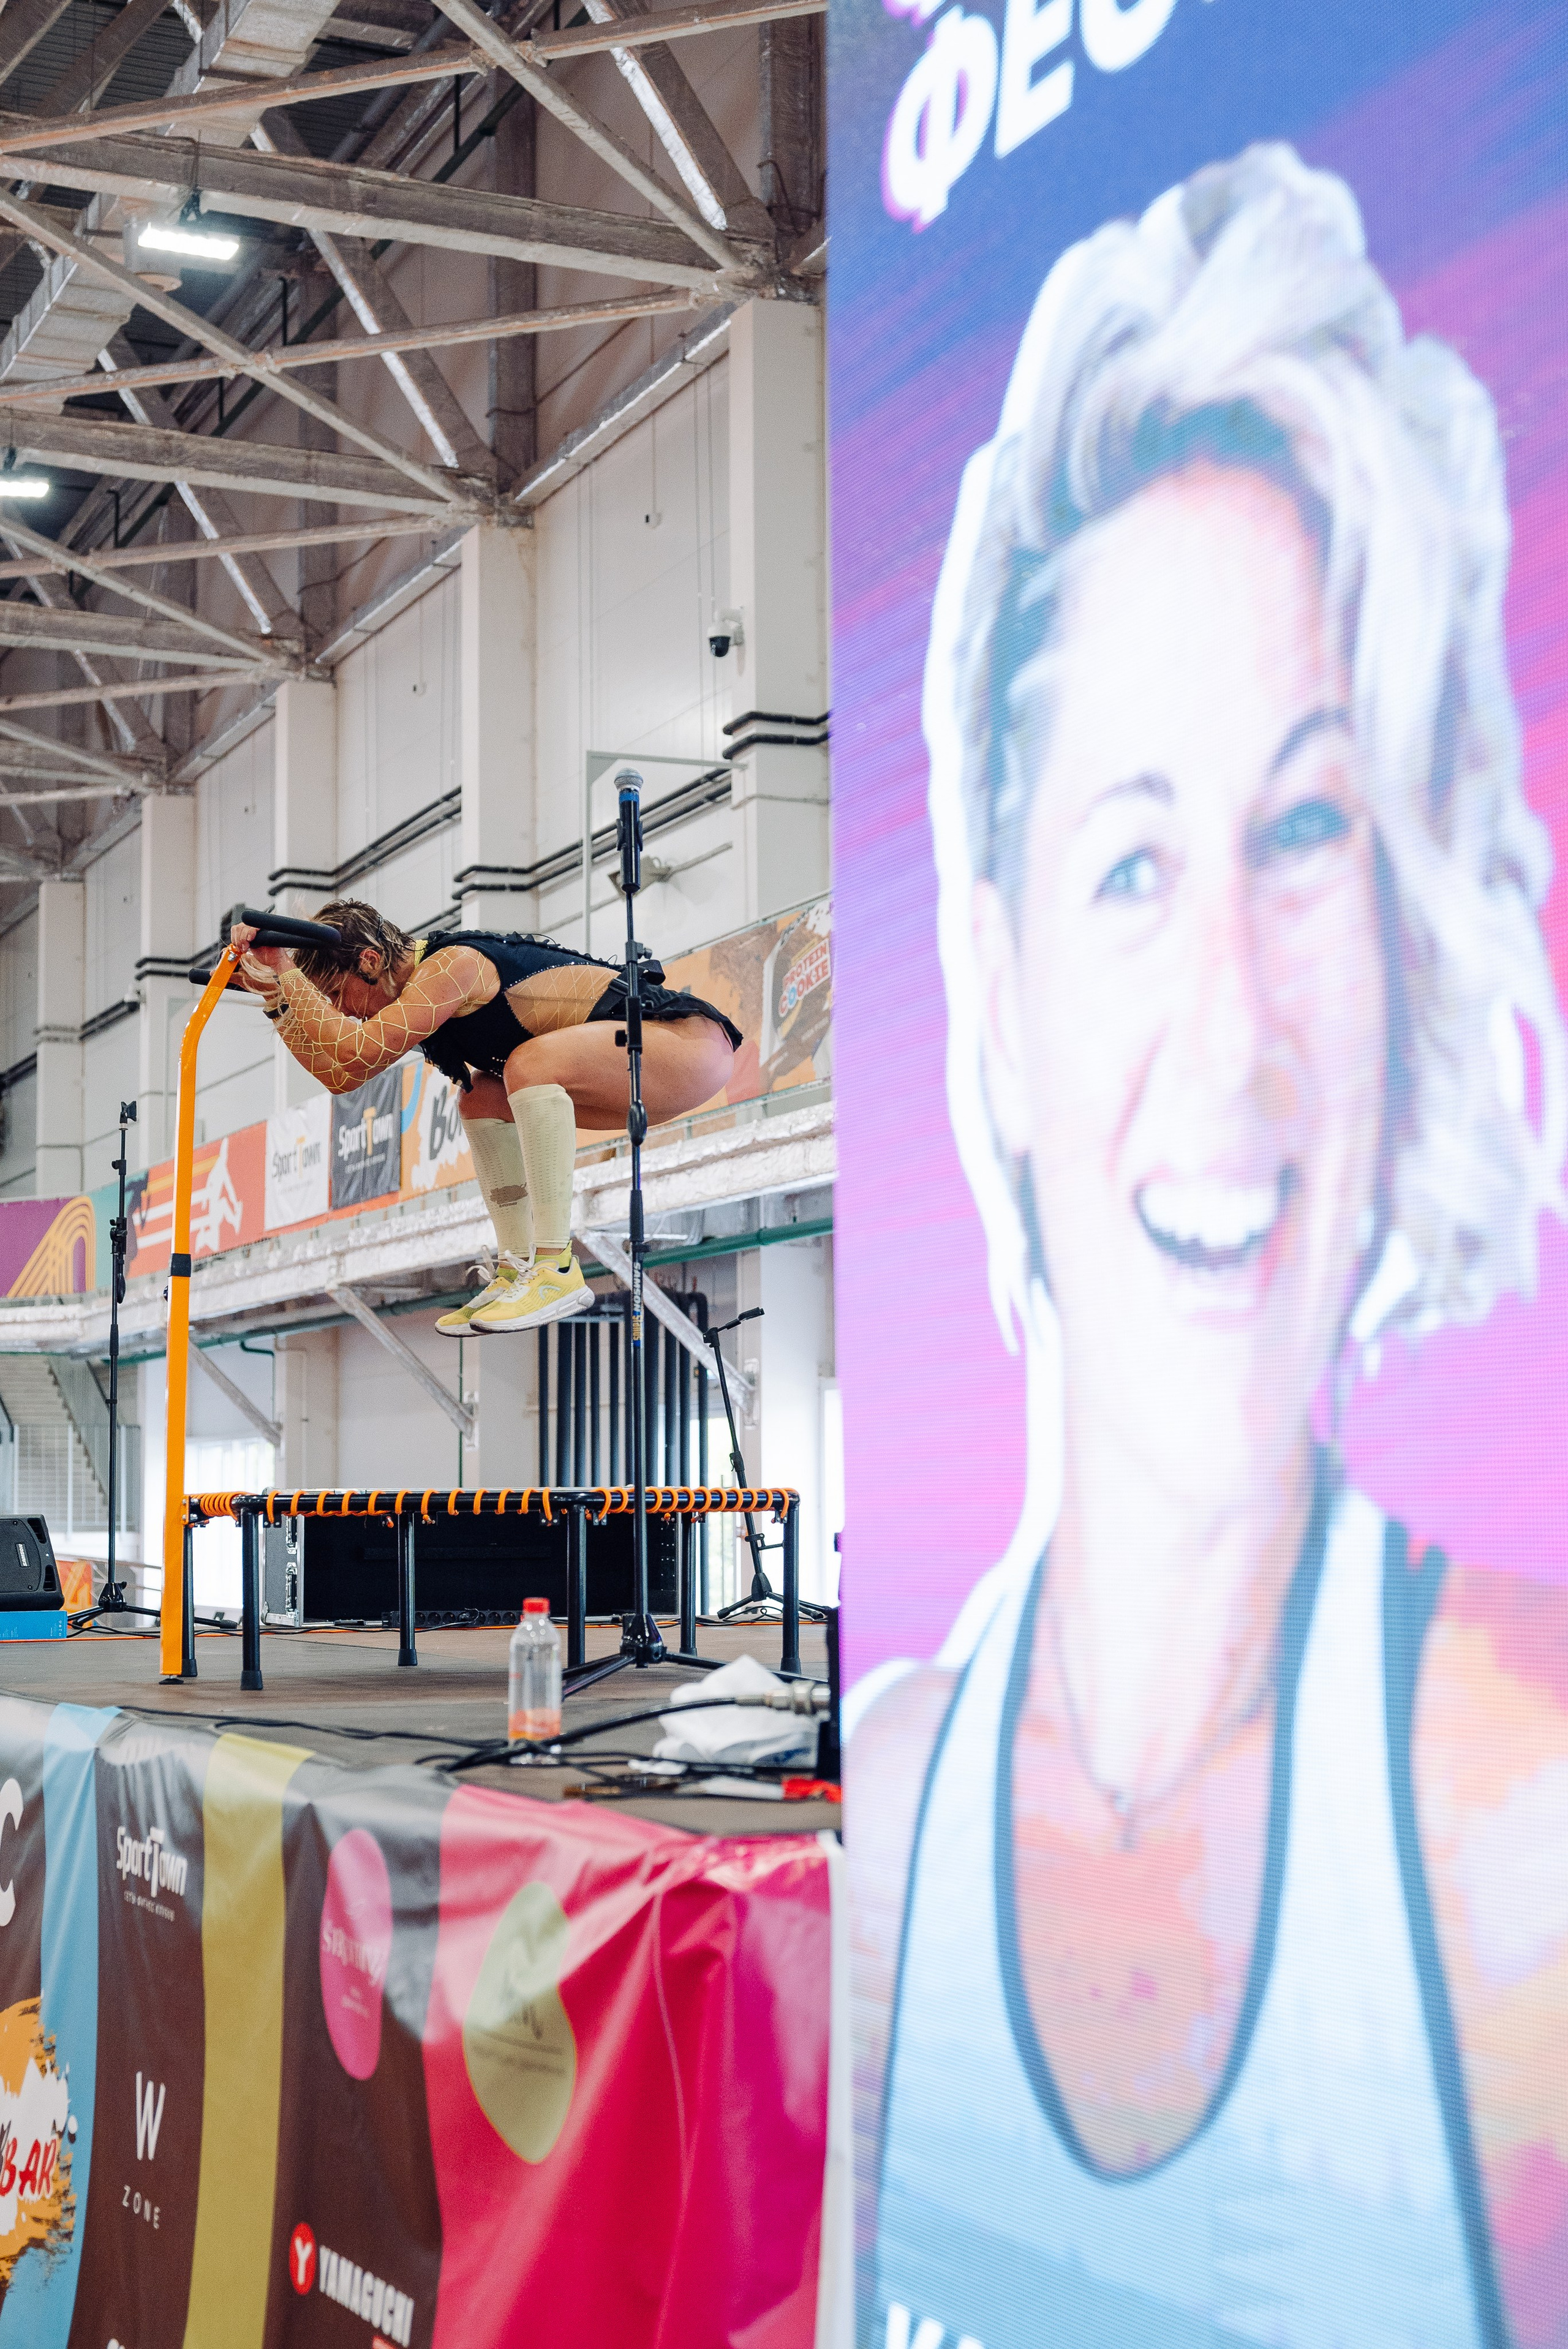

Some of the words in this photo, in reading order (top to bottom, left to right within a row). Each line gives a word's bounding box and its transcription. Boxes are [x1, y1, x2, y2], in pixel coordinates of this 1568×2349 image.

[779, 959, 829, 1014] COOKIE
[783, 941, 827, 991] PROTEIN
[18, 1543, 28, 1567] SAMSON
[136, 2071, 166, 2160] W
[123, 2184, 160, 2230] ZONE
[318, 2245, 415, 2348] YAMAGUCHI
